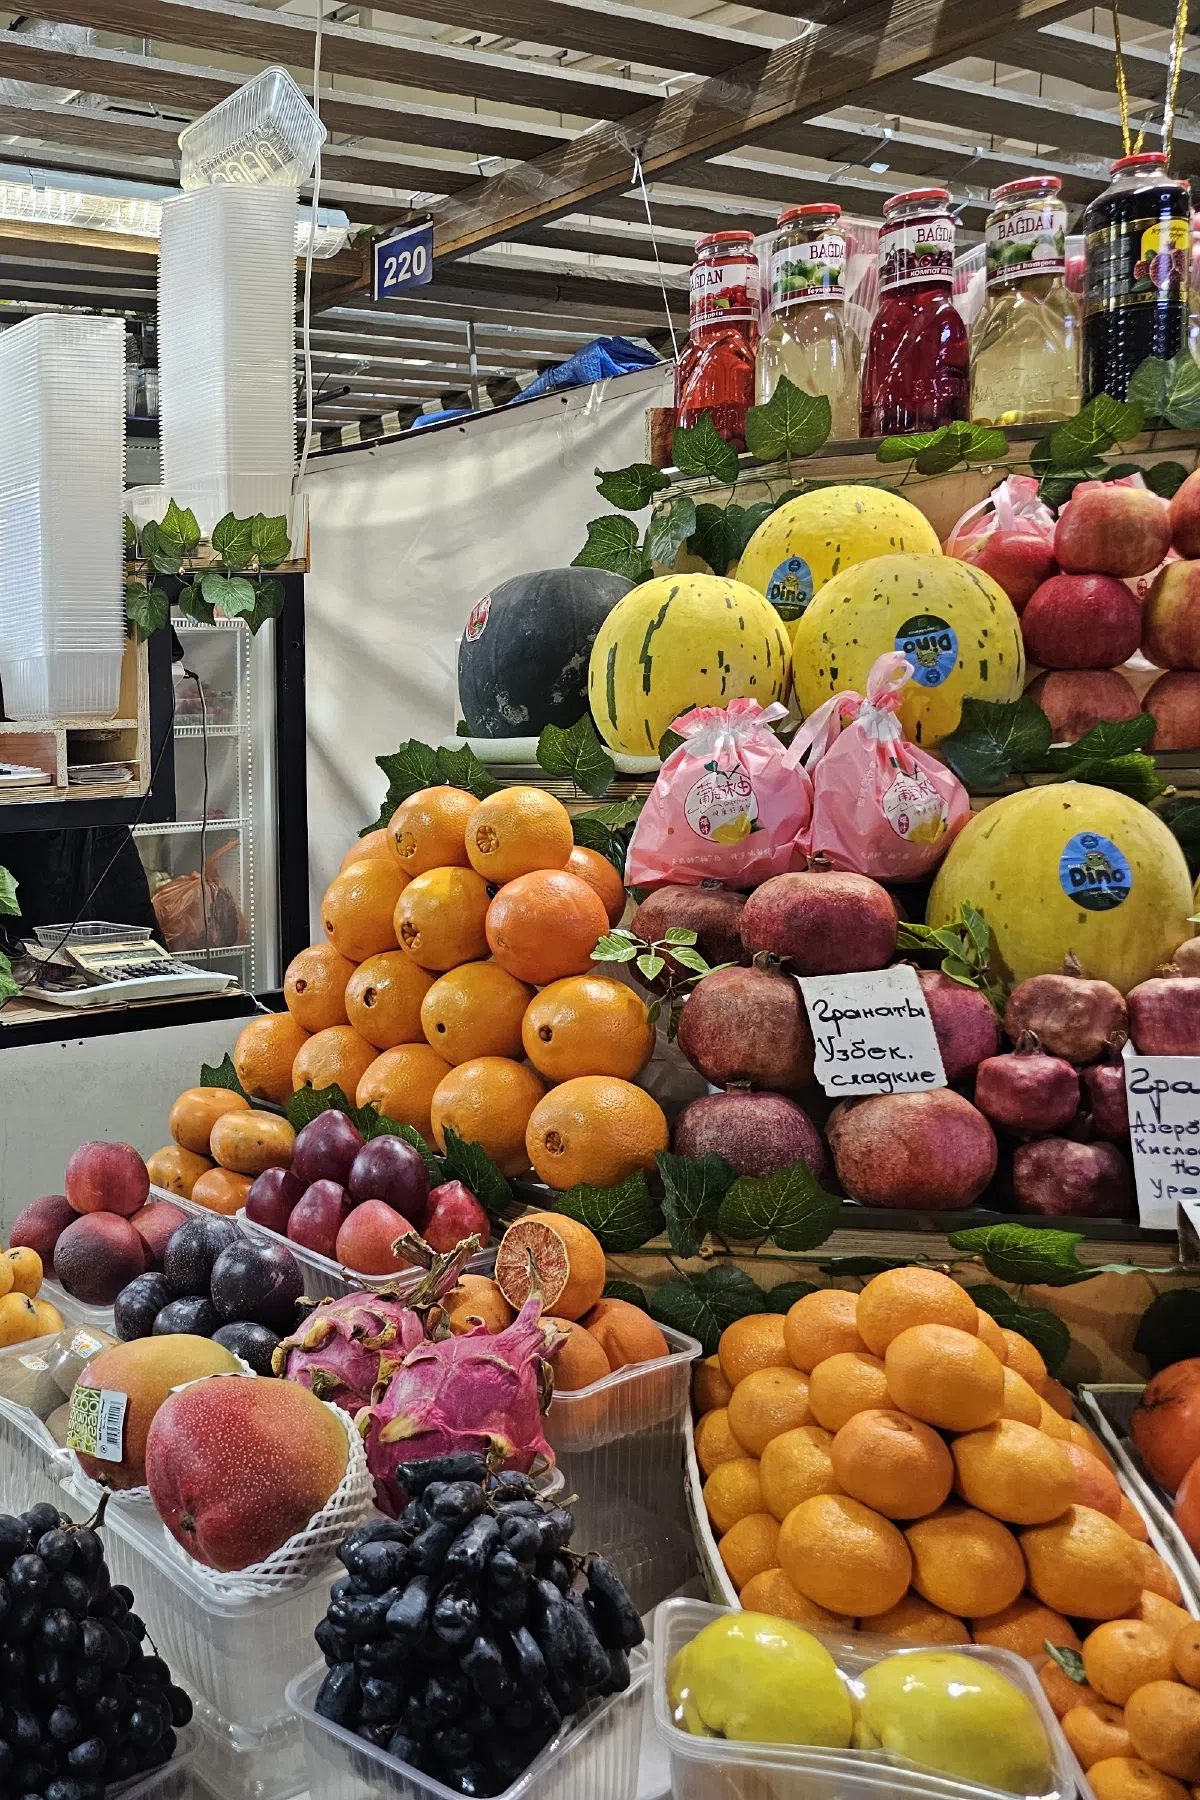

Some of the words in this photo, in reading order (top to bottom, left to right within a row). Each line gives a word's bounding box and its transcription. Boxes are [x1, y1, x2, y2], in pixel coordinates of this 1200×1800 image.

[998, 214, 1054, 240] BAĞDAN
[384, 245, 427, 288] 220
[770, 584, 807, 602] Dino
[903, 633, 952, 653] Dino
[1068, 867, 1126, 888] Dino
[812, 997, 926, 1038] Гранаты
[817, 1035, 914, 1063] Узбек.
[830, 1071, 937, 1094] сладкие
[1134, 1137, 1200, 1156] Кисло
[1149, 1177, 1200, 1200] Уро
